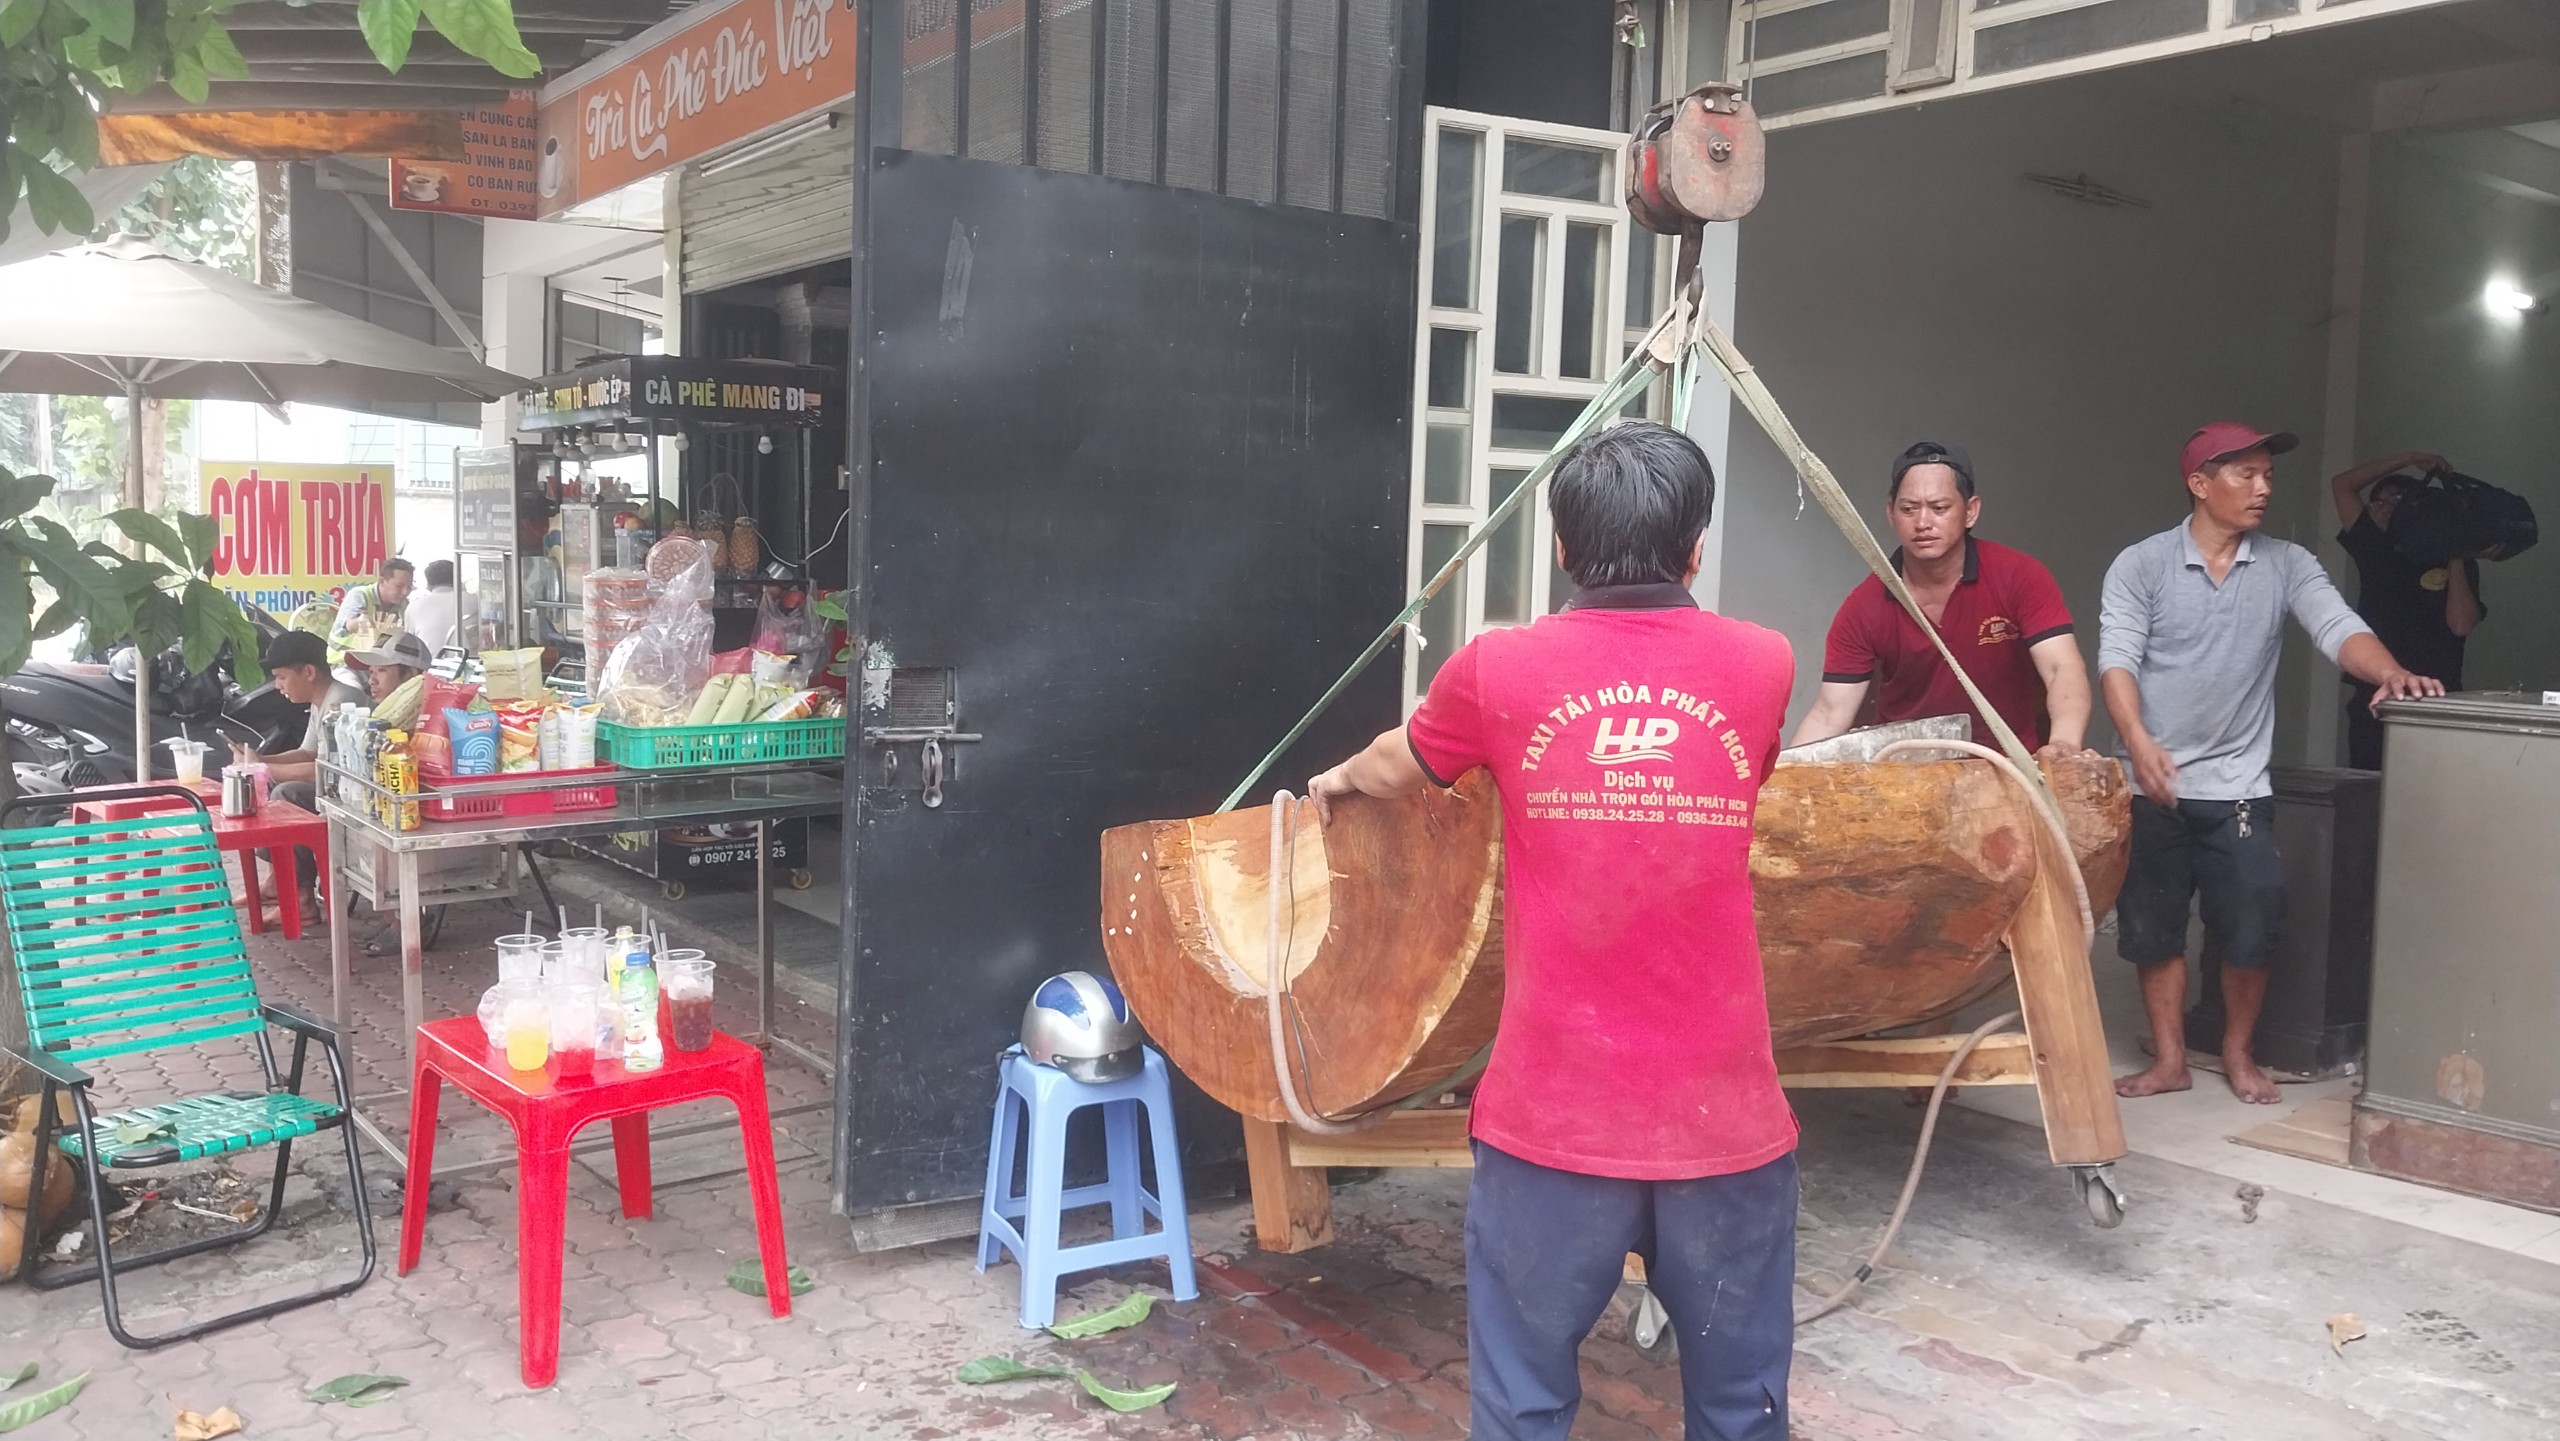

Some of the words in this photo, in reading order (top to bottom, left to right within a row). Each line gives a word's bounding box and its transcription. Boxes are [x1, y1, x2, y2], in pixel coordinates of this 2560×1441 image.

[586, 88, 627, 161] Trà
[657, 46, 708, 129] Phê
[712, 18, 767, 104] Đức
[774, 0, 833, 82] Việt
[480, 111, 513, 127] CUNG
[476, 154, 504, 169] VINH
[509, 158, 533, 172] BAO
[488, 177, 513, 191] BAN
[645, 375, 673, 405] CÀ
[678, 377, 717, 407] PHÊ
[723, 383, 781, 410] MANG
[785, 387, 805, 412] ĐI
[210, 468, 291, 577] CƠM
[300, 472, 388, 577] TRƯA
[255, 585, 317, 612] PHÒNG
[1522, 723, 1556, 772] TAXI
[1548, 693, 1593, 726] TẢI
[1597, 680, 1652, 707] HÒA
[1660, 687, 1727, 729] PHÁT
[1719, 728, 1751, 780] HCM
[1604, 770, 1646, 791] Dịch
[1652, 776, 1674, 792] vụ
[1526, 787, 1568, 804] CHUYỂN
[1571, 789, 1597, 804] NHÀ
[1600, 792, 1637, 807] TRỌN
[1640, 791, 1663, 806] GÓI
[1667, 791, 1693, 807] HÒA
[1696, 794, 1726, 809] PHÁT
[1728, 799, 1748, 812] HCM
[1526, 807, 1569, 819] HOTLINE:
[1572, 808, 1665, 823] 0938.24.25.28
[704, 851, 734, 864] 0907
[736, 850, 751, 861] 24
[772, 846, 786, 858] 25
